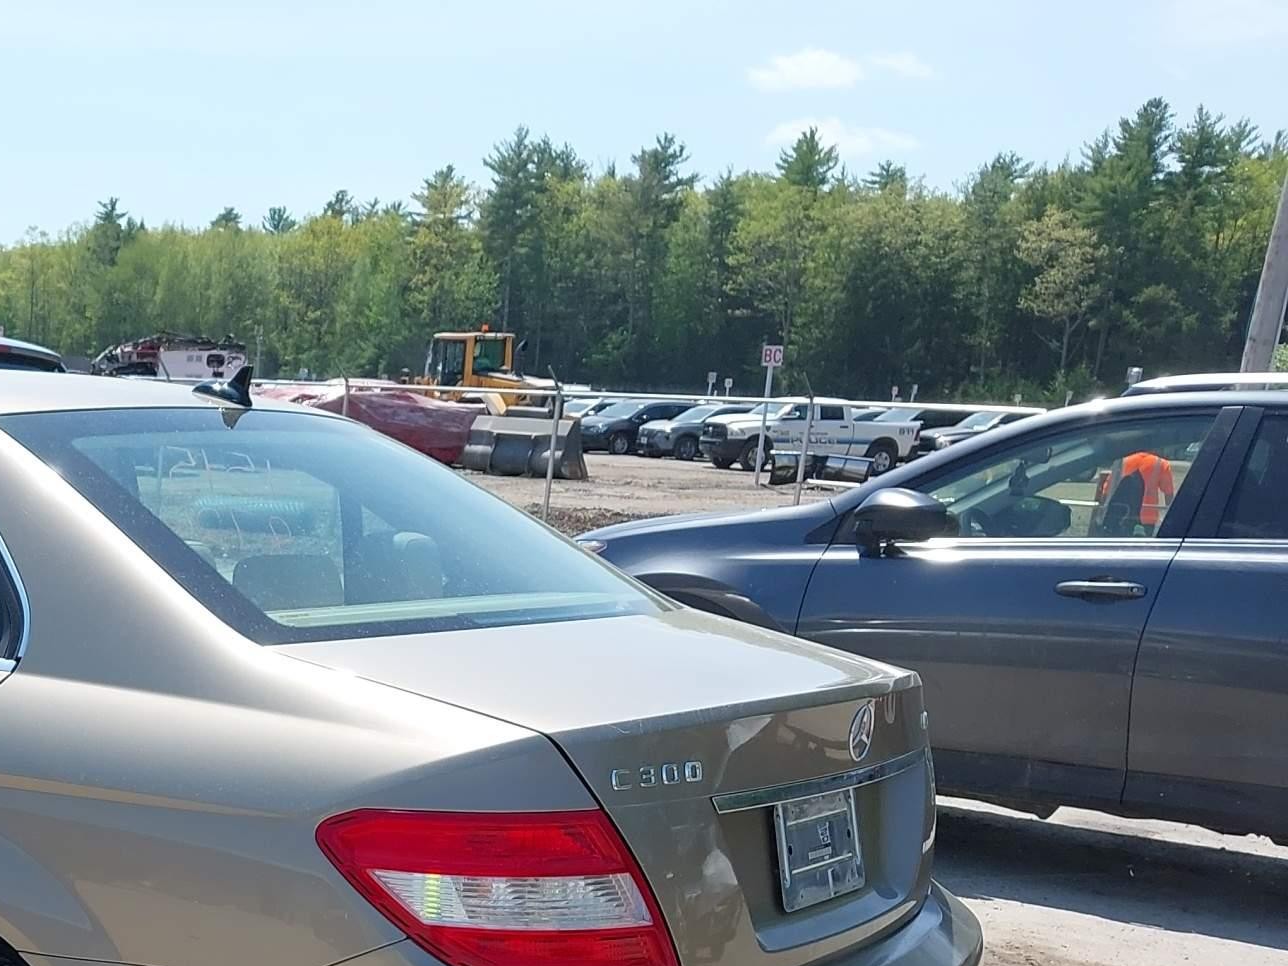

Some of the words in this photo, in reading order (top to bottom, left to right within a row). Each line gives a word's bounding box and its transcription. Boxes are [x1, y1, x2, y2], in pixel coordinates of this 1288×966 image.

[764, 348, 782, 364] BC
[612, 768, 632, 791] C
[639, 760, 703, 788] 300
